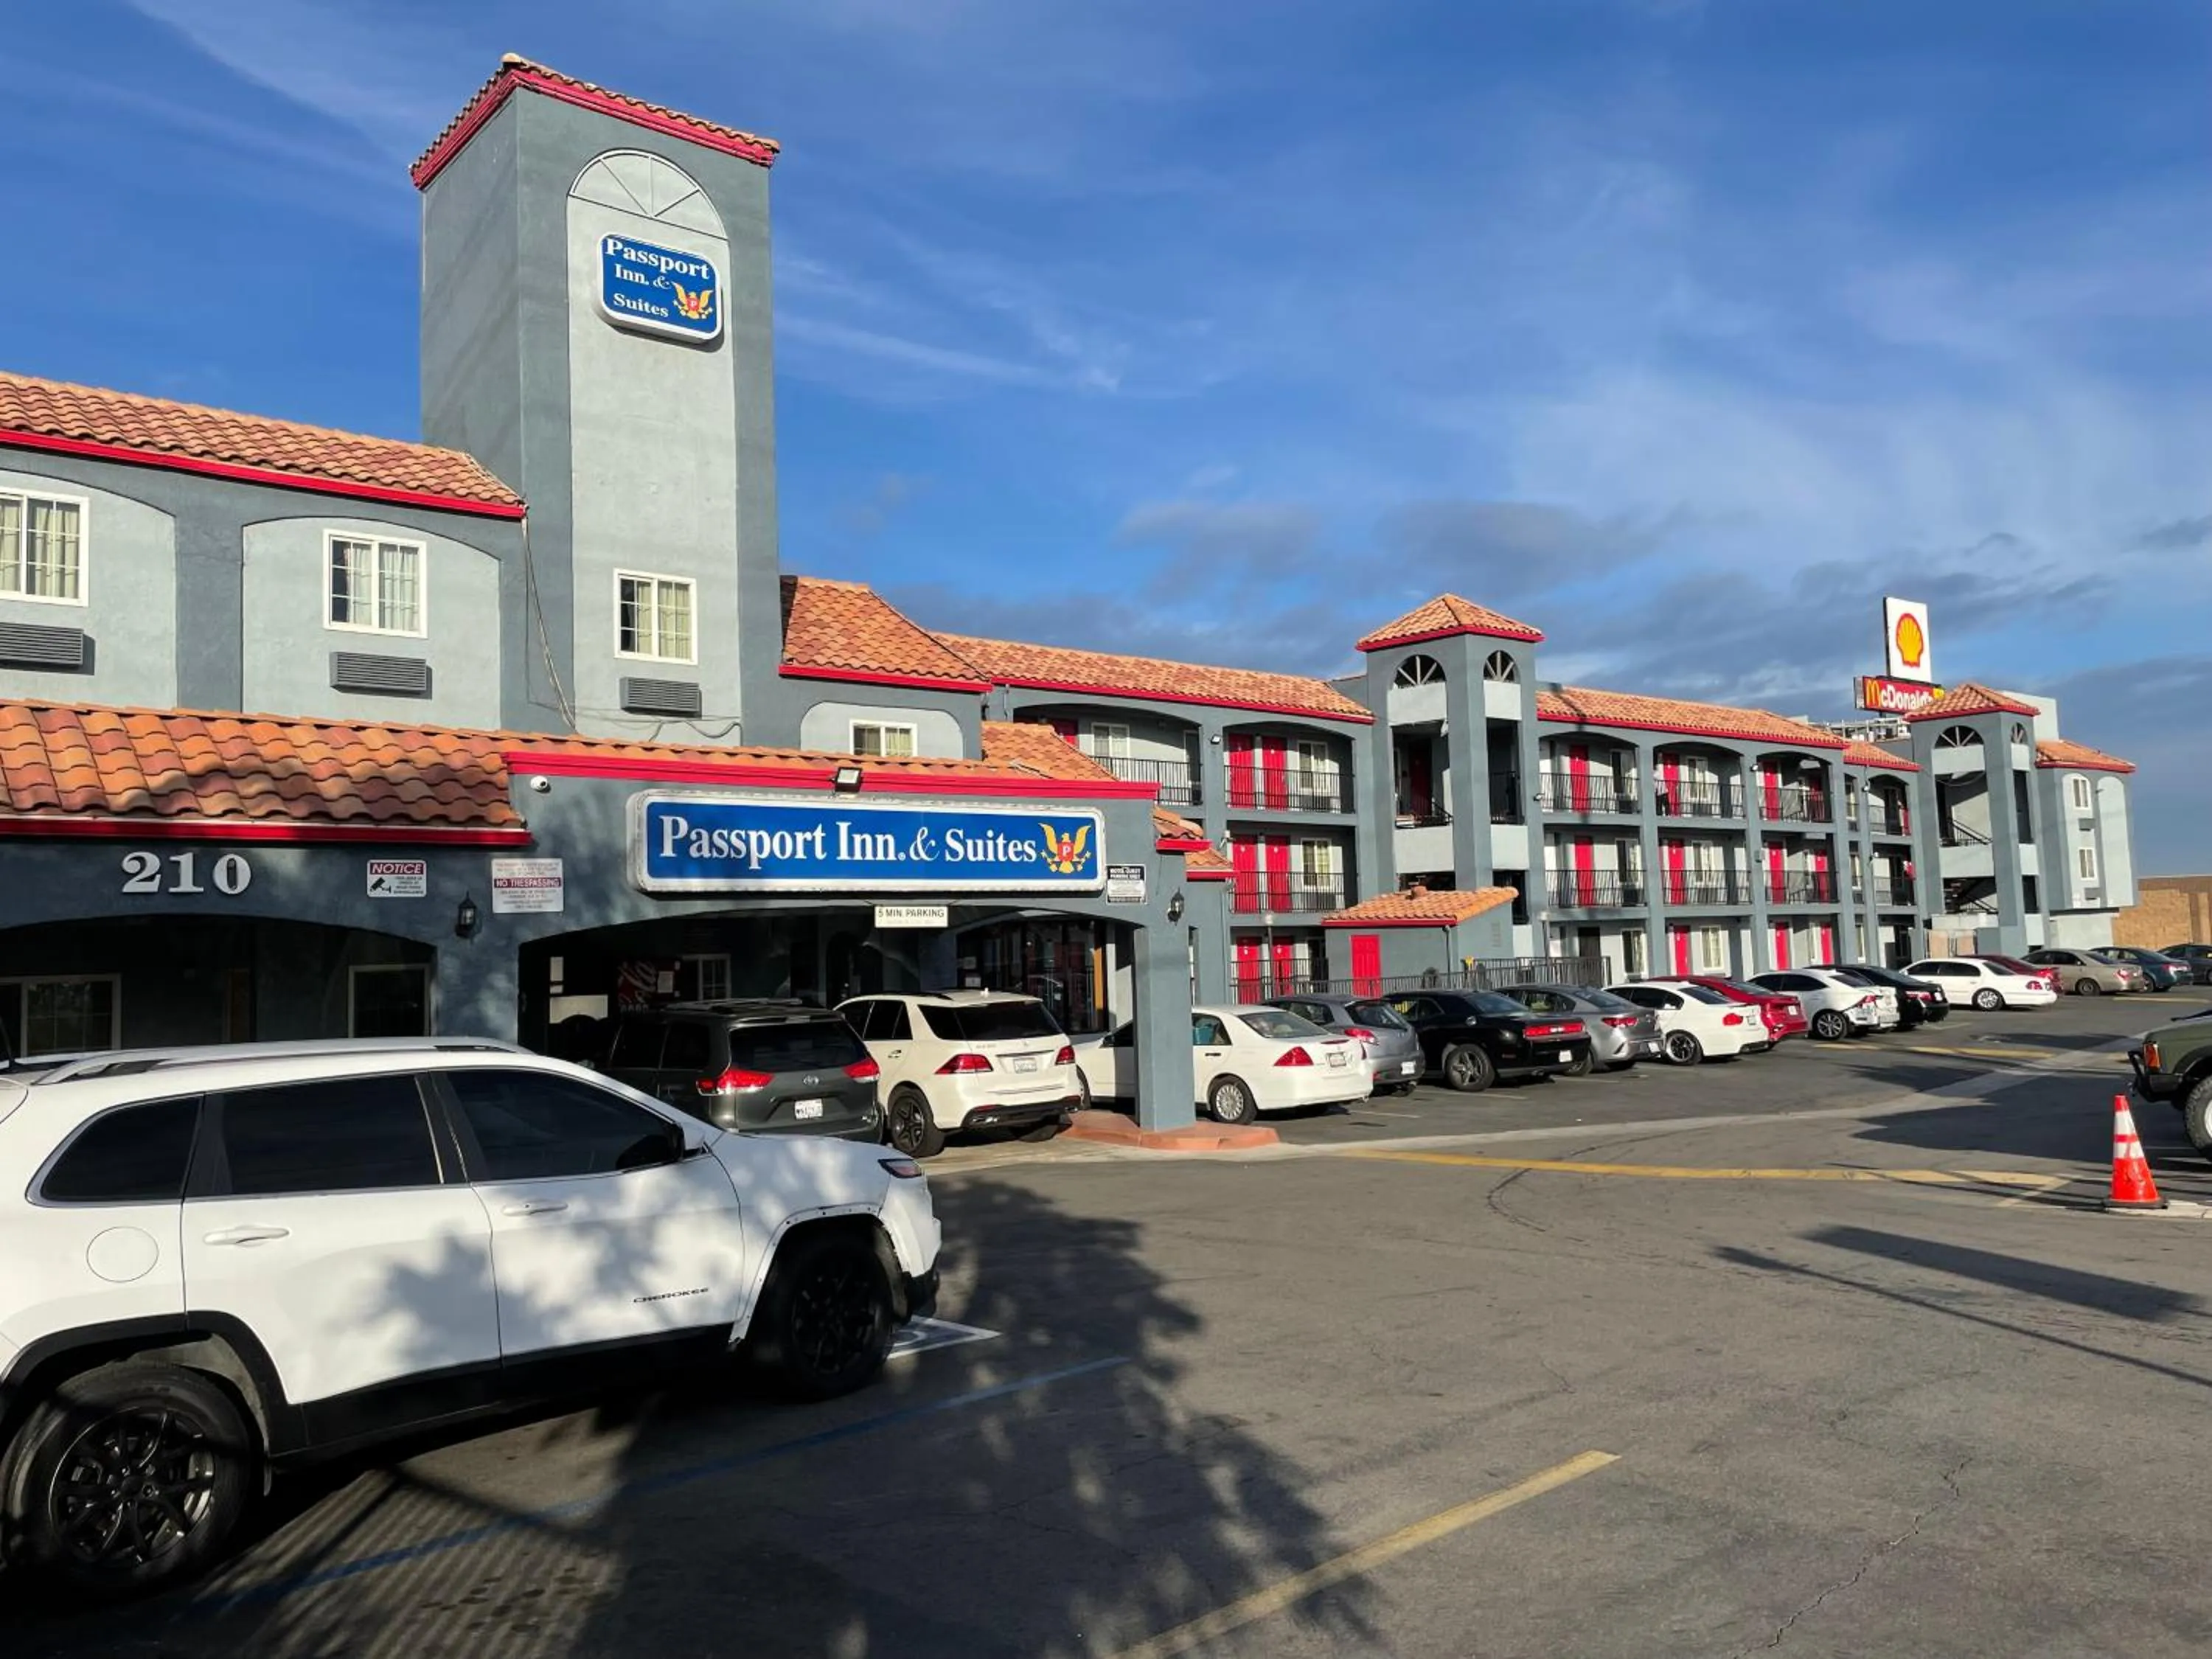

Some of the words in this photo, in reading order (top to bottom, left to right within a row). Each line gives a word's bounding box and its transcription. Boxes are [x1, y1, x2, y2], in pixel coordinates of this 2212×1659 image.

[605, 239, 710, 279] Passport
[615, 263, 650, 285] Inn.
[653, 275, 671, 290] &
[613, 293, 669, 318] Suites
[659, 815, 827, 869] Passport
[835, 821, 906, 861] Inn.
[909, 827, 940, 861] &
[945, 828, 1037, 862] Suites
[1062, 846, 1071, 856] P
[122, 852, 251, 894] 210
[372, 863, 422, 874] NOTICE
[496, 879, 508, 887] NO
[511, 877, 560, 887] TRESPASSING
[878, 908, 883, 918] 5
[905, 908, 945, 917] PARKING
[633, 1287, 709, 1303] CHEROKEE
